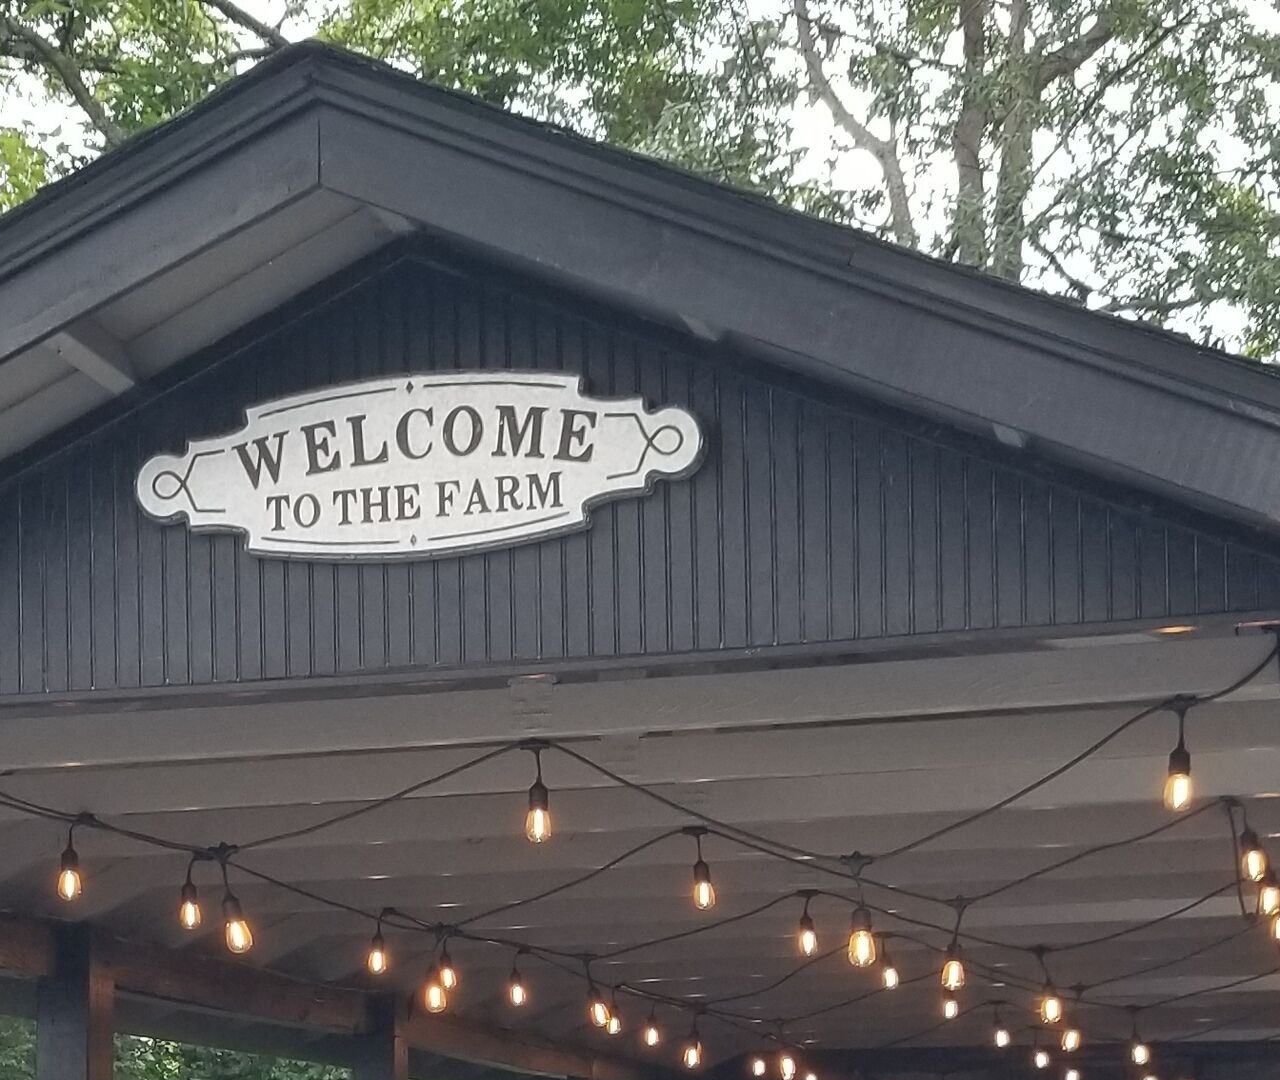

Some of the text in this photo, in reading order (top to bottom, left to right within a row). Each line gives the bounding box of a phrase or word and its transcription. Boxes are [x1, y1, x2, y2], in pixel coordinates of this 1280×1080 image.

[232, 405, 598, 490] WELCOME
[266, 471, 563, 531] TO THE FARM
